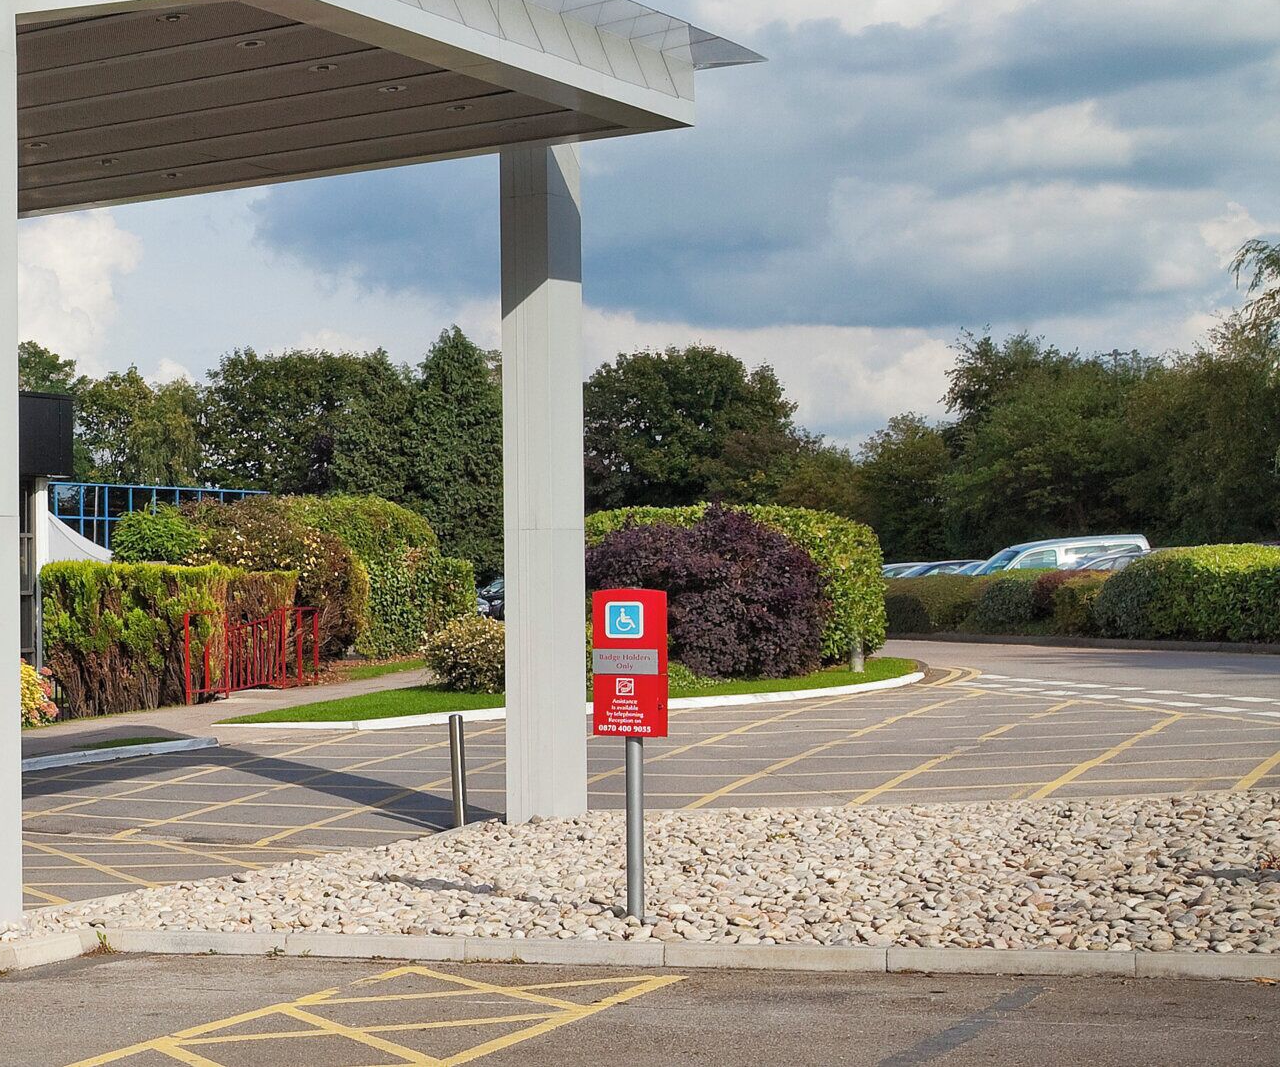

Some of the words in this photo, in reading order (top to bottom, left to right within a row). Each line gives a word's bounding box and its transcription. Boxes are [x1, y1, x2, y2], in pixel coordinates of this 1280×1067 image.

[599, 654, 620, 662] Badge
[616, 662, 633, 670] Only
[598, 724, 617, 732] 0870
